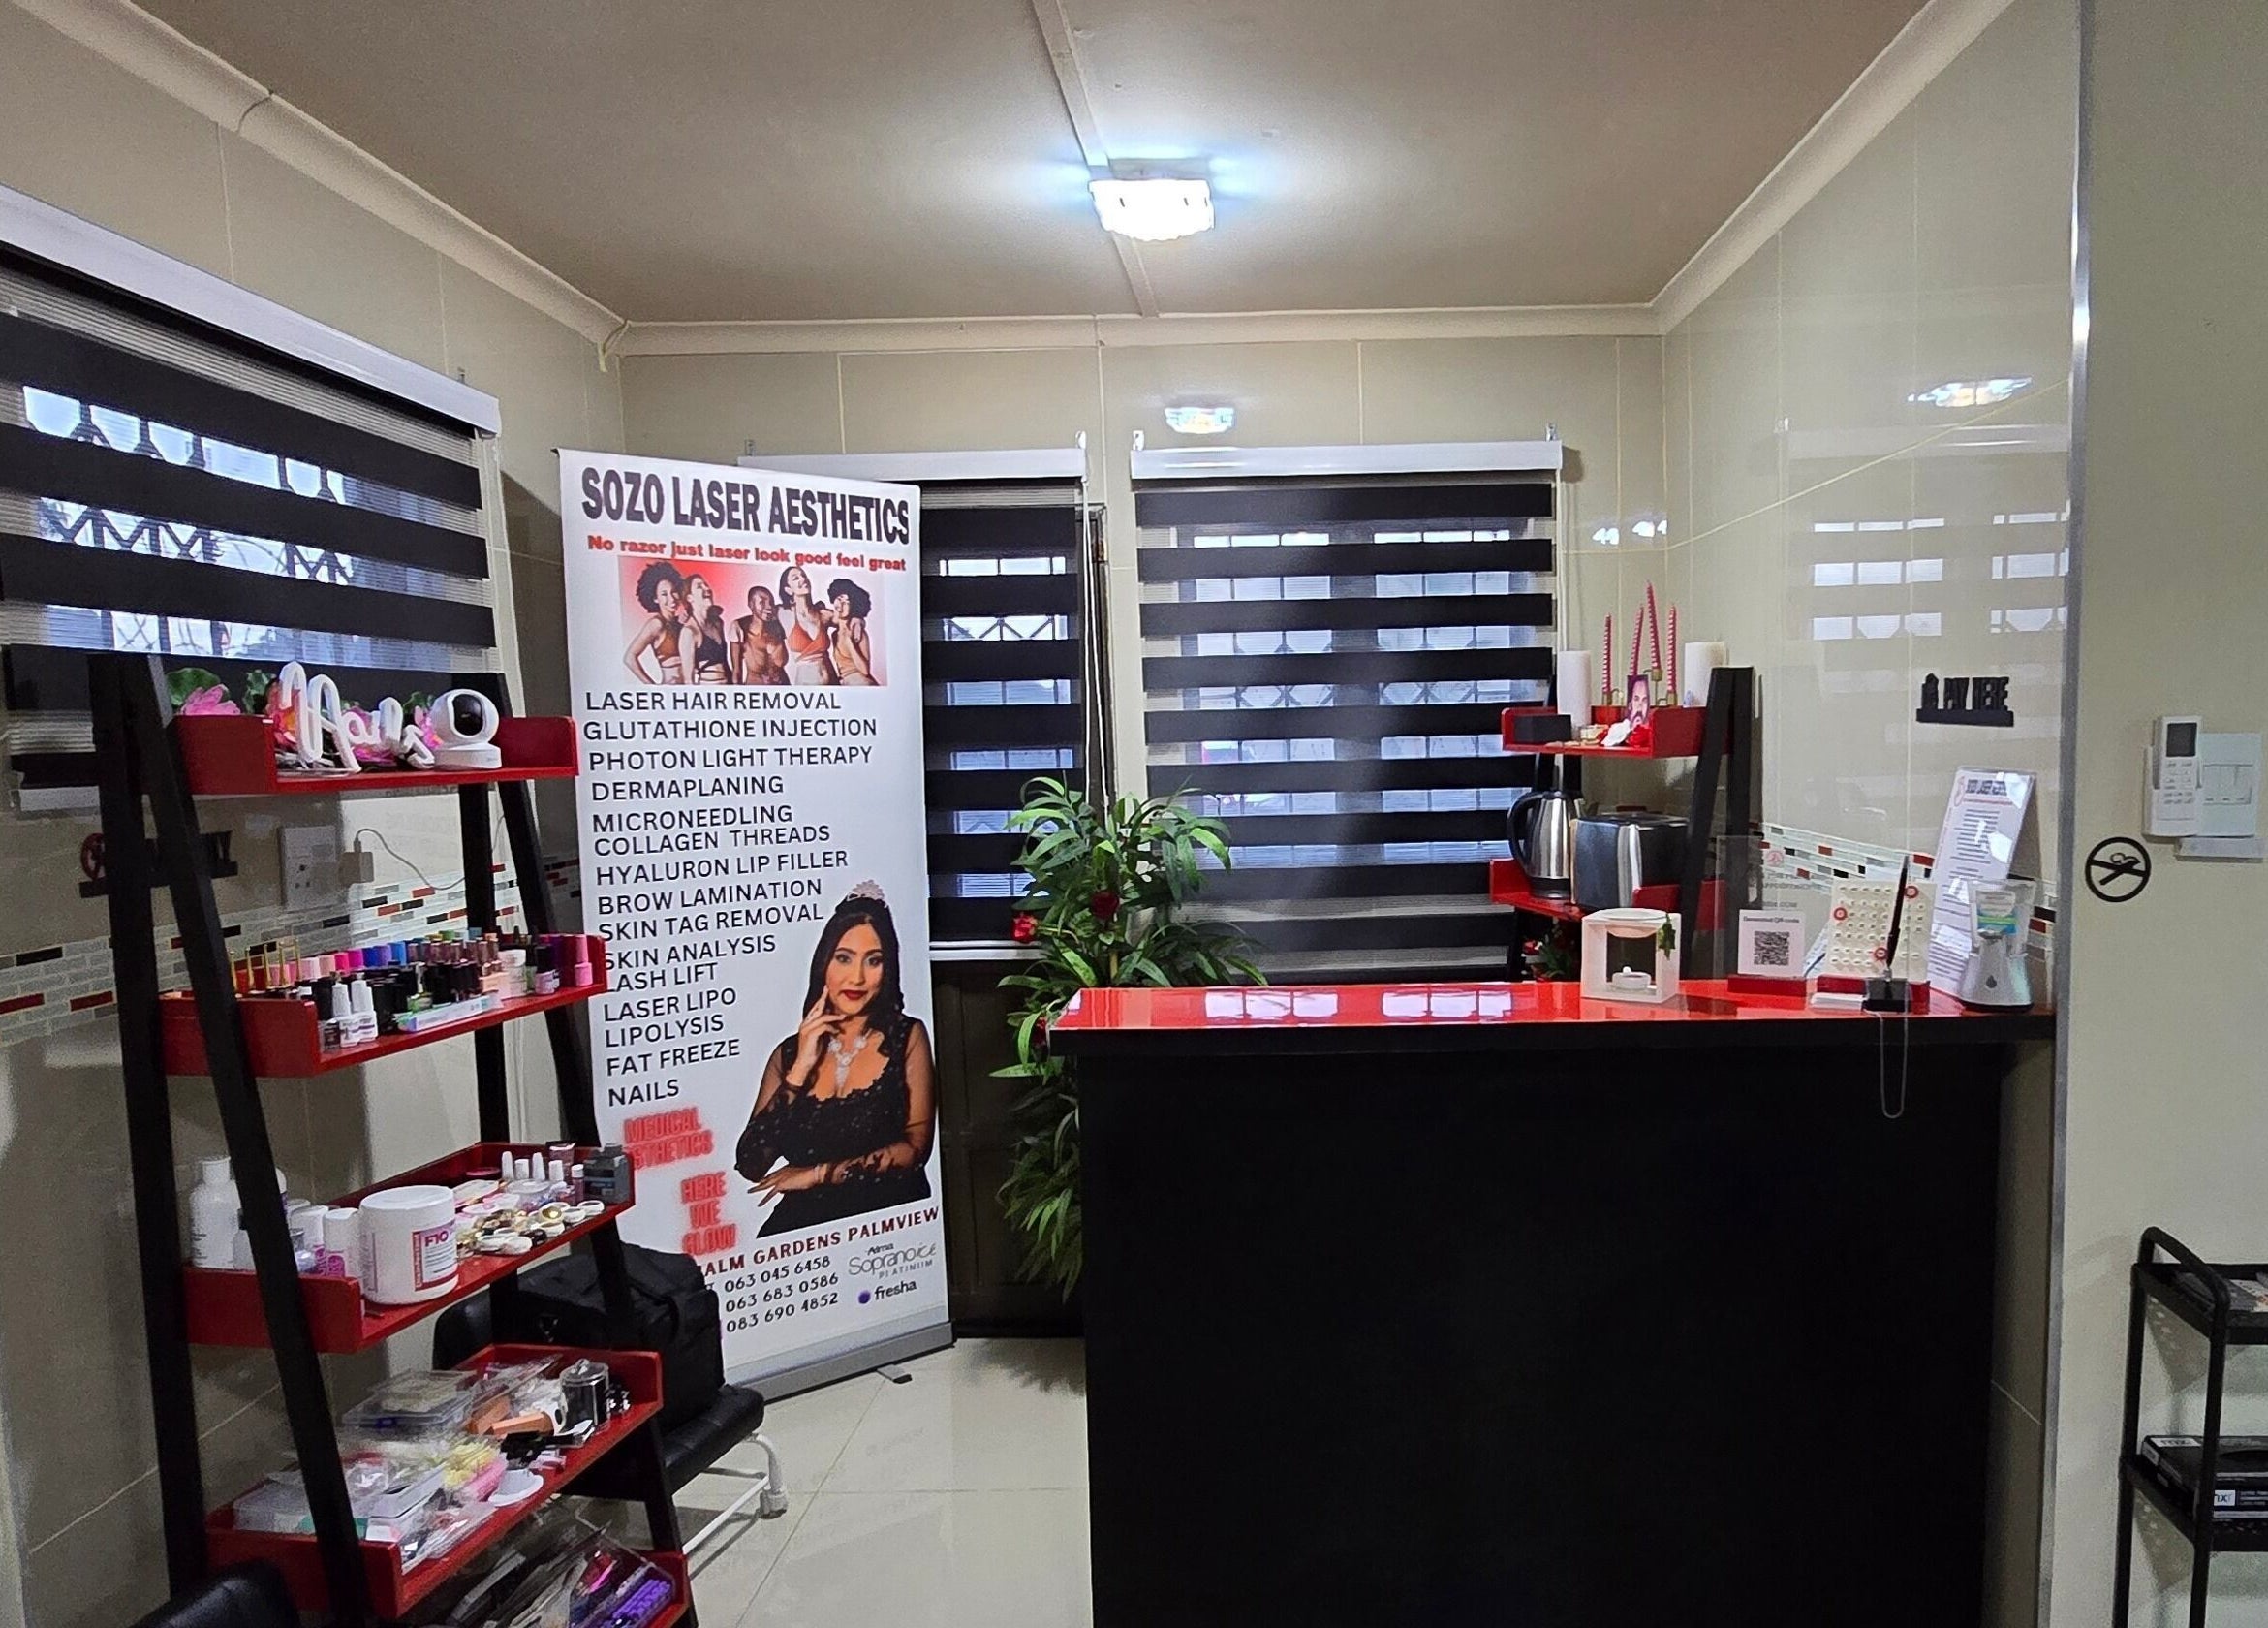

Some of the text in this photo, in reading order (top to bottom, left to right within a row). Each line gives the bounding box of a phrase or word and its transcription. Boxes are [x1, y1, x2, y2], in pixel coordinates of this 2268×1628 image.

[581, 467, 910, 545] SOZO LASER AESTHETICS
[587, 535, 906, 572] No razor just laser look good feel great
[586, 692, 841, 710] LASER HAIR REMOVAL
[583, 719, 877, 740] GLUTATHIONE INJECTION
[589, 745, 872, 771] PHOTON LIGHT THERAPY
[592, 775, 784, 800] DERMAPLANING
[593, 804, 792, 832] MICRONEEDLING
[594, 825, 830, 856] COLLAGEN THREADS
[597, 850, 849, 885] HYALURON LIP FILLER
[598, 878, 822, 915] BROW LAMINATION
[598, 903, 823, 942] SKIN TAG REMOVAL
[606, 934, 776, 970] SKIN ANALYSIS
[674, 962, 718, 985] LIFT
[604, 987, 736, 1022] LASER LIPO
[605, 1014, 725, 1048] LIPOLYSIS
[606, 1039, 740, 1077] FAT FREEZE
[607, 1079, 679, 1107] NAILS
[697, 1206, 940, 1277] ALM GARDENS PALMVIEW
[725, 1255, 831, 1293] 063 045 6458
[874, 1280, 917, 1300] fresha
[726, 1272, 839, 1313] 063 683 0586
[727, 1292, 839, 1332] 083 690 4852
